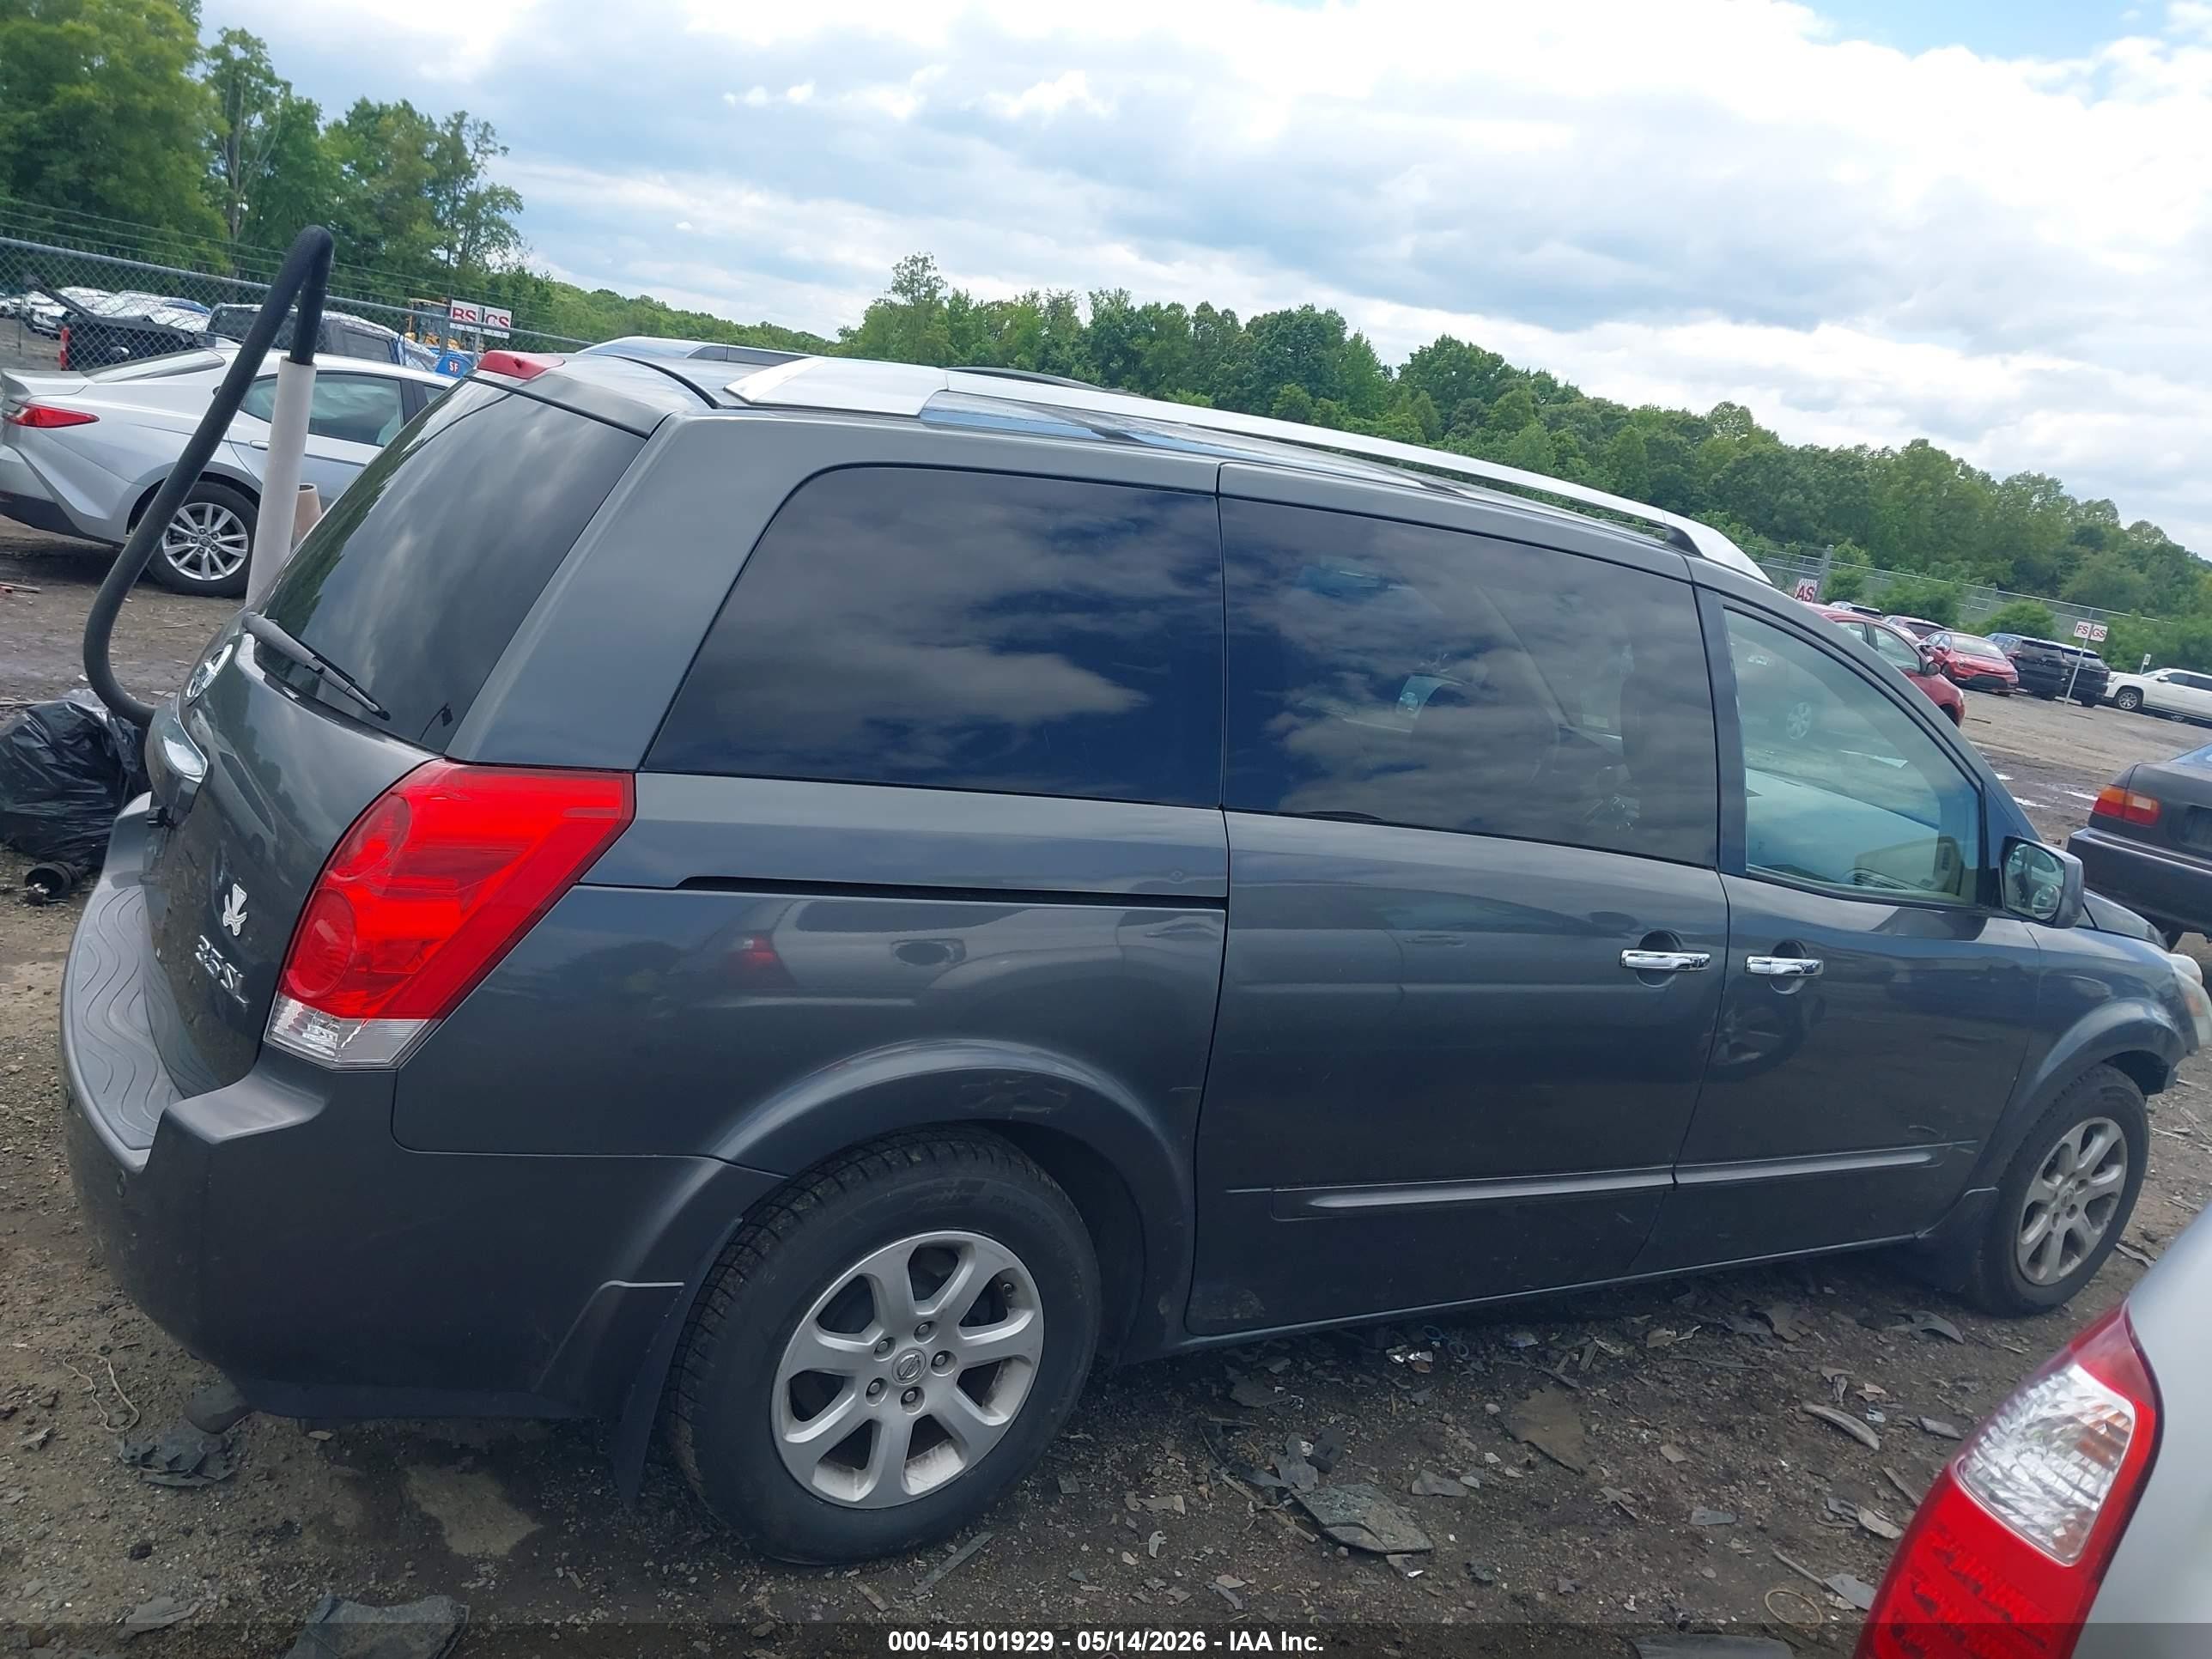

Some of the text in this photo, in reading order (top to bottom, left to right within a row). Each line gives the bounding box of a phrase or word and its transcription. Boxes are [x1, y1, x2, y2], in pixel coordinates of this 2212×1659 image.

[1796, 585, 1814, 602] AS
[2076, 624, 2089, 635] FS
[2092, 628, 2106, 638] GS
